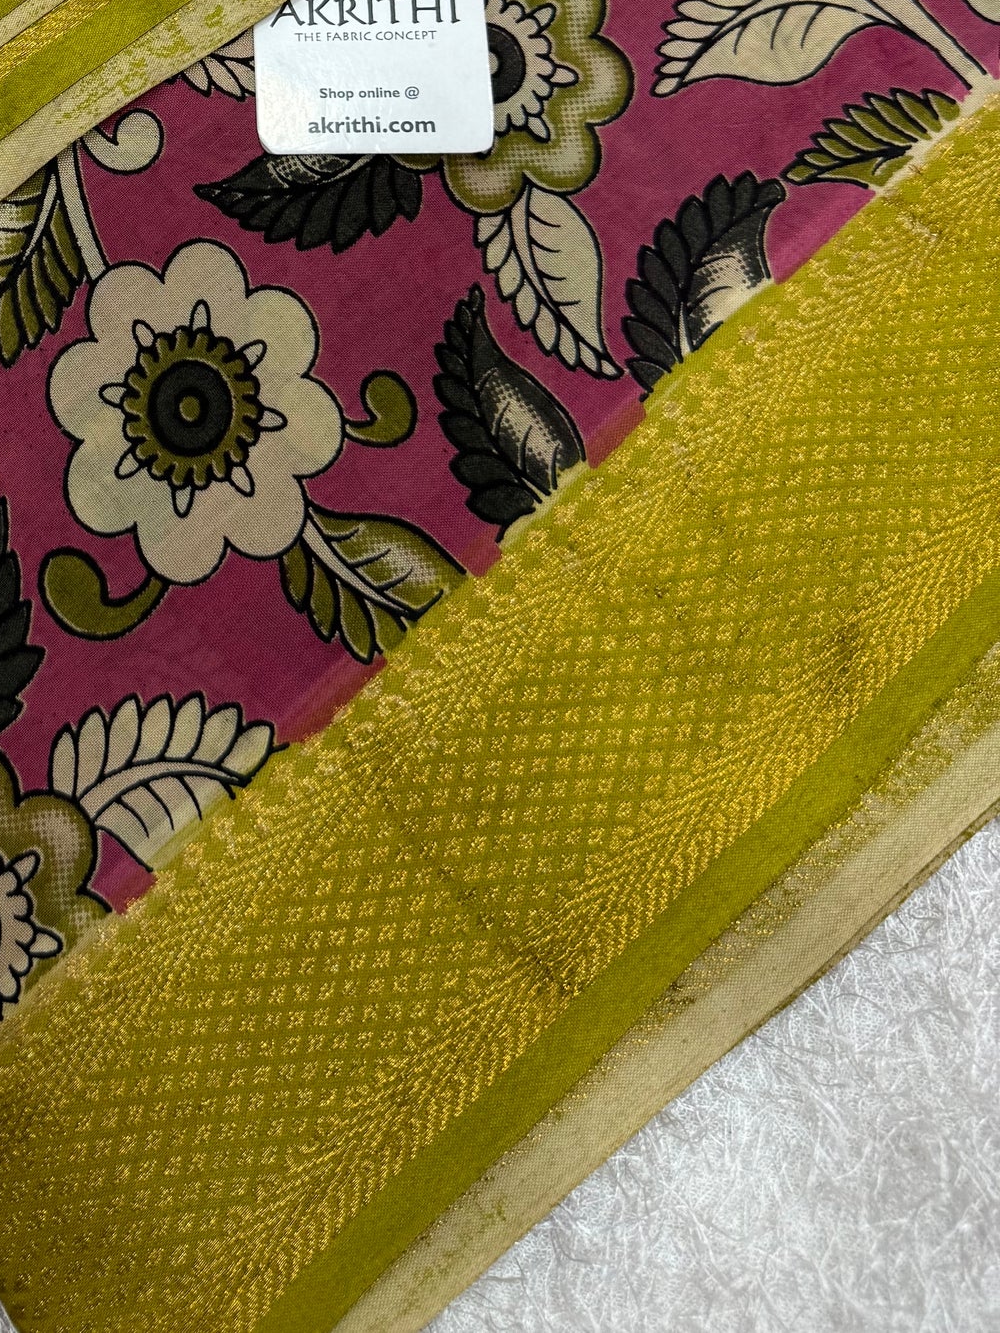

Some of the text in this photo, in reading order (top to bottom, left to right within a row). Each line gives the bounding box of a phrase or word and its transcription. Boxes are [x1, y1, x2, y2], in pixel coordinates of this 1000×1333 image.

[294, 30, 437, 42] THE FABRIC CONCEPT
[319, 86, 420, 100] Shop online @
[308, 116, 436, 134] akrithi.com
